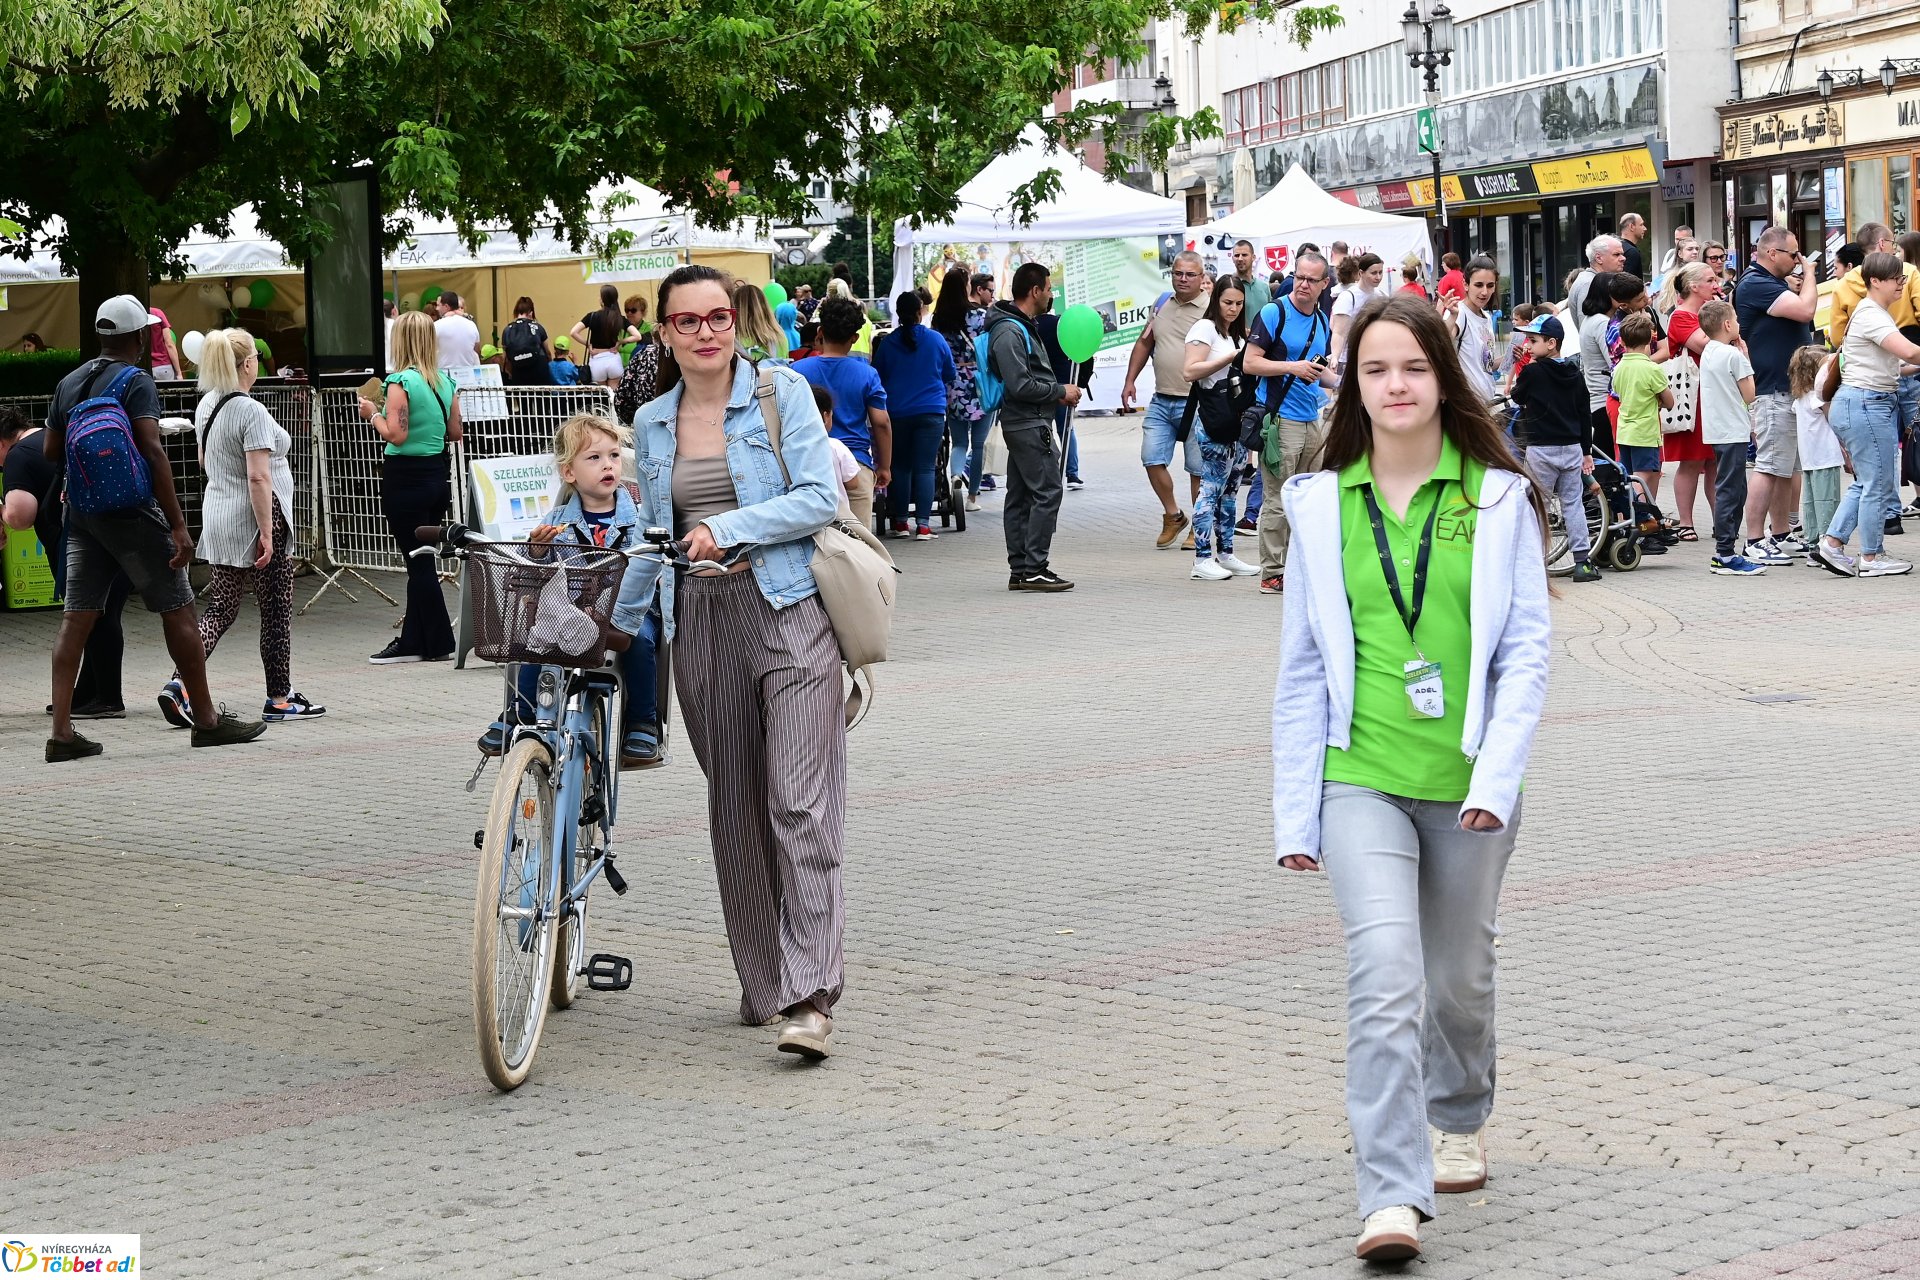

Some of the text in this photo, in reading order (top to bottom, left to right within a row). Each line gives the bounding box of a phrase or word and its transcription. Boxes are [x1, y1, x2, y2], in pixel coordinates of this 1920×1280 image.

[1896, 99, 1920, 127] MA
[1588, 171, 1609, 182] TAILOR
[1662, 183, 1694, 197] TOM TAILO
[493, 464, 553, 480] SZELEKTÁLÓ
[503, 479, 548, 492] VERSENY
[1415, 686, 1437, 694] ADÉL
